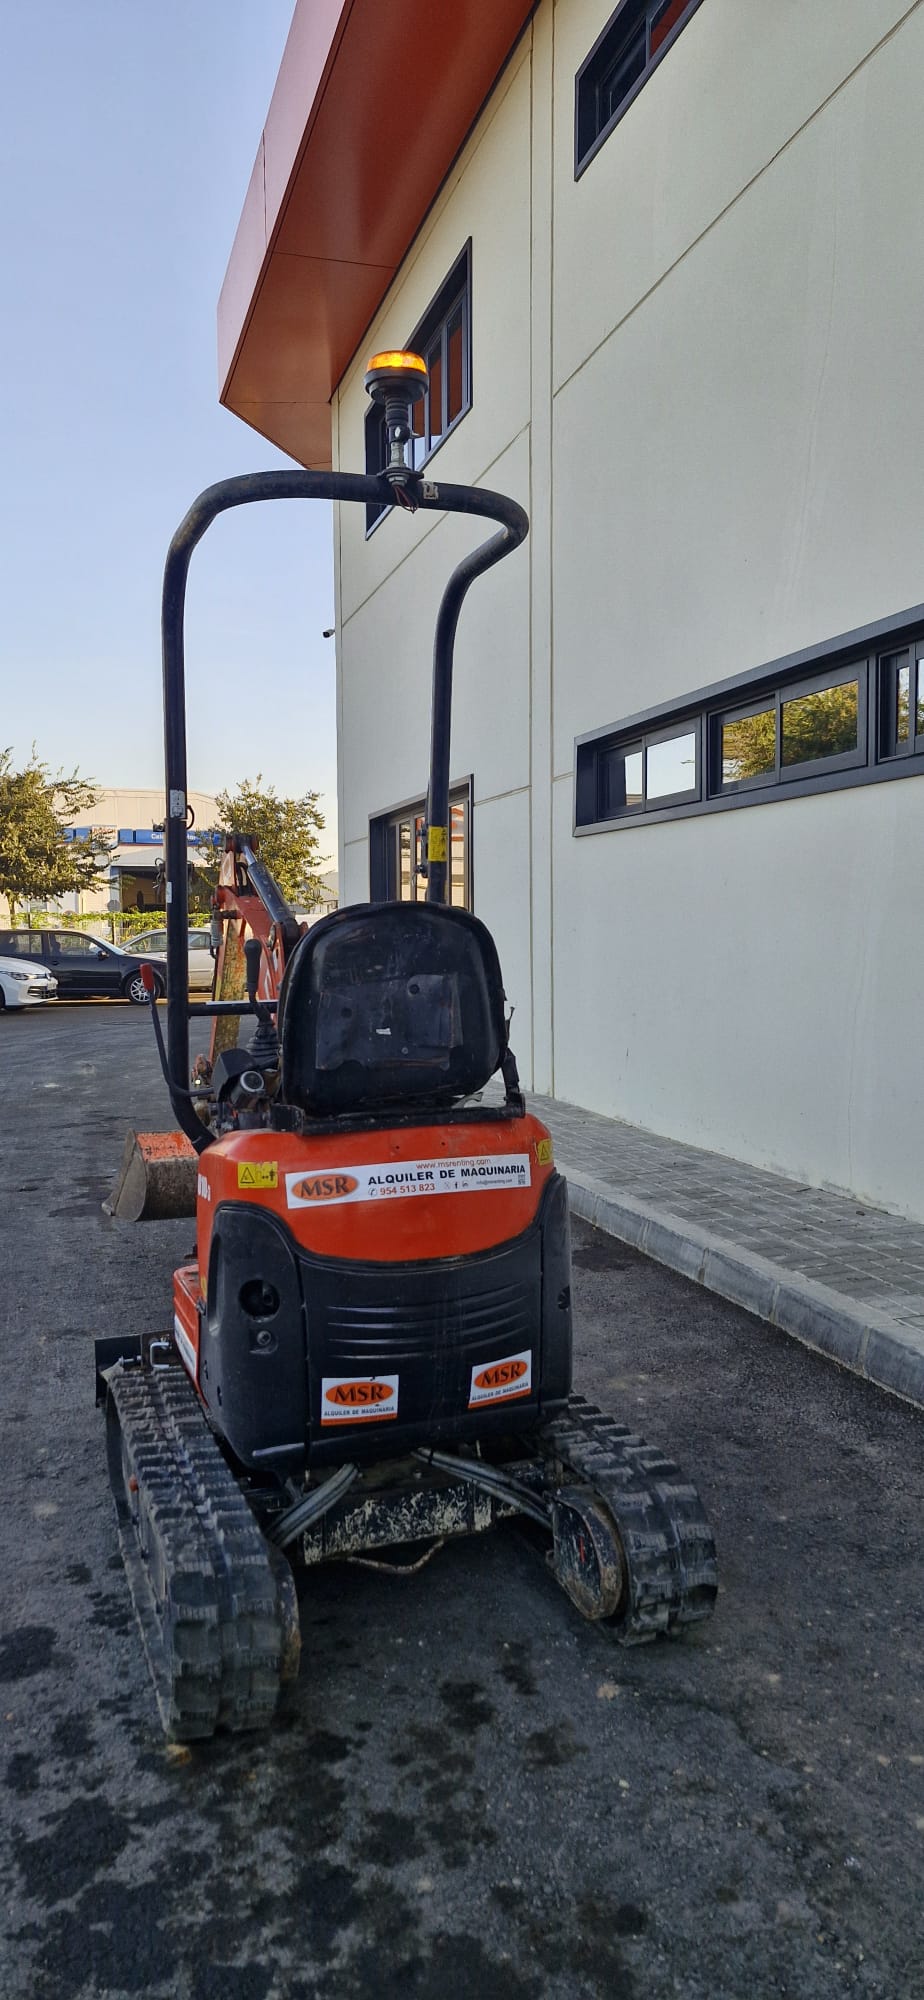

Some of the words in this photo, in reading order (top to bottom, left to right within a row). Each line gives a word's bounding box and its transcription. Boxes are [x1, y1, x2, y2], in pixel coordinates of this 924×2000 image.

[368, 1171, 434, 1185] ALQUILER
[439, 1169, 456, 1179] DE
[461, 1165, 526, 1177] MAQUINARIA
[301, 1177, 350, 1198] MSR
[380, 1187, 397, 1196] 954
[400, 1185, 416, 1194] 513
[418, 1183, 436, 1192] 823
[480, 1362, 520, 1387] MSR
[334, 1384, 384, 1404] MSR
[323, 1409, 350, 1417] ALQUILER
[361, 1405, 395, 1415] MAQUINARIA
